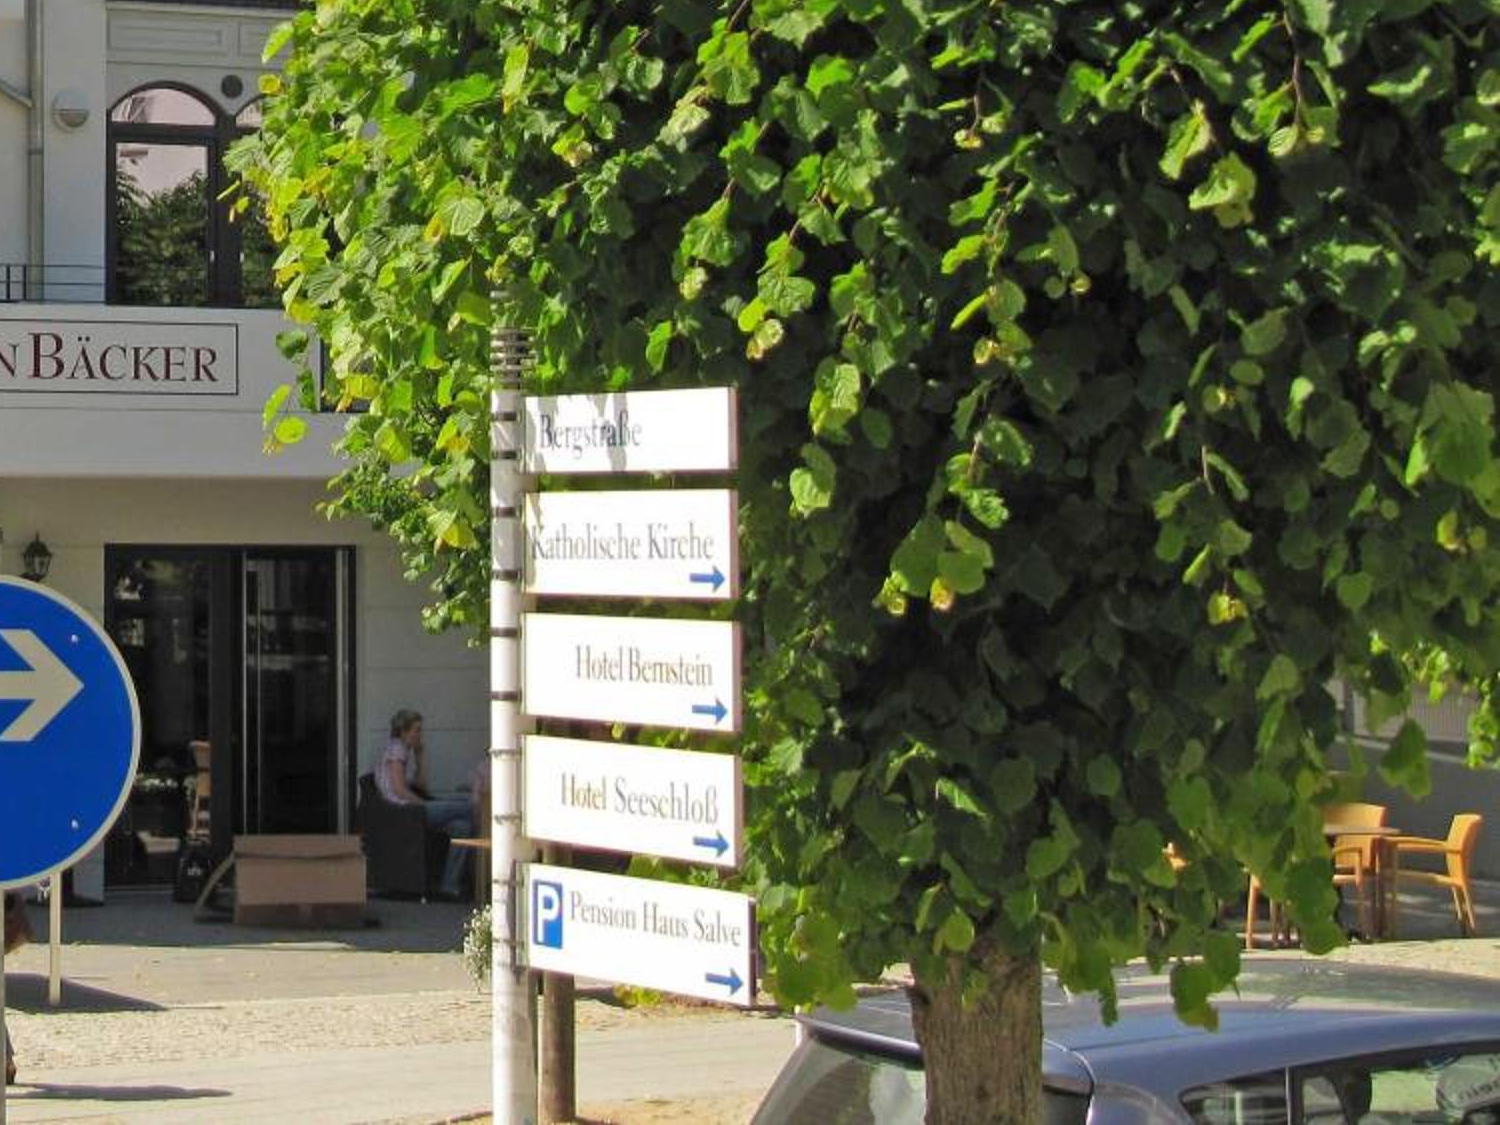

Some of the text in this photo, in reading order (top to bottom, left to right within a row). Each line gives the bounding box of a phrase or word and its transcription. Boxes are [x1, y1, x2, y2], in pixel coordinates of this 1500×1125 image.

[540, 410, 642, 459] Bergstraße
[531, 520, 714, 561] Katholische Kirche
[576, 644, 713, 686] Hotel Bernstein
[561, 772, 718, 825] Hotel Seeschloß
[537, 881, 561, 943] P
[570, 890, 741, 947] Pension Haus Salve
